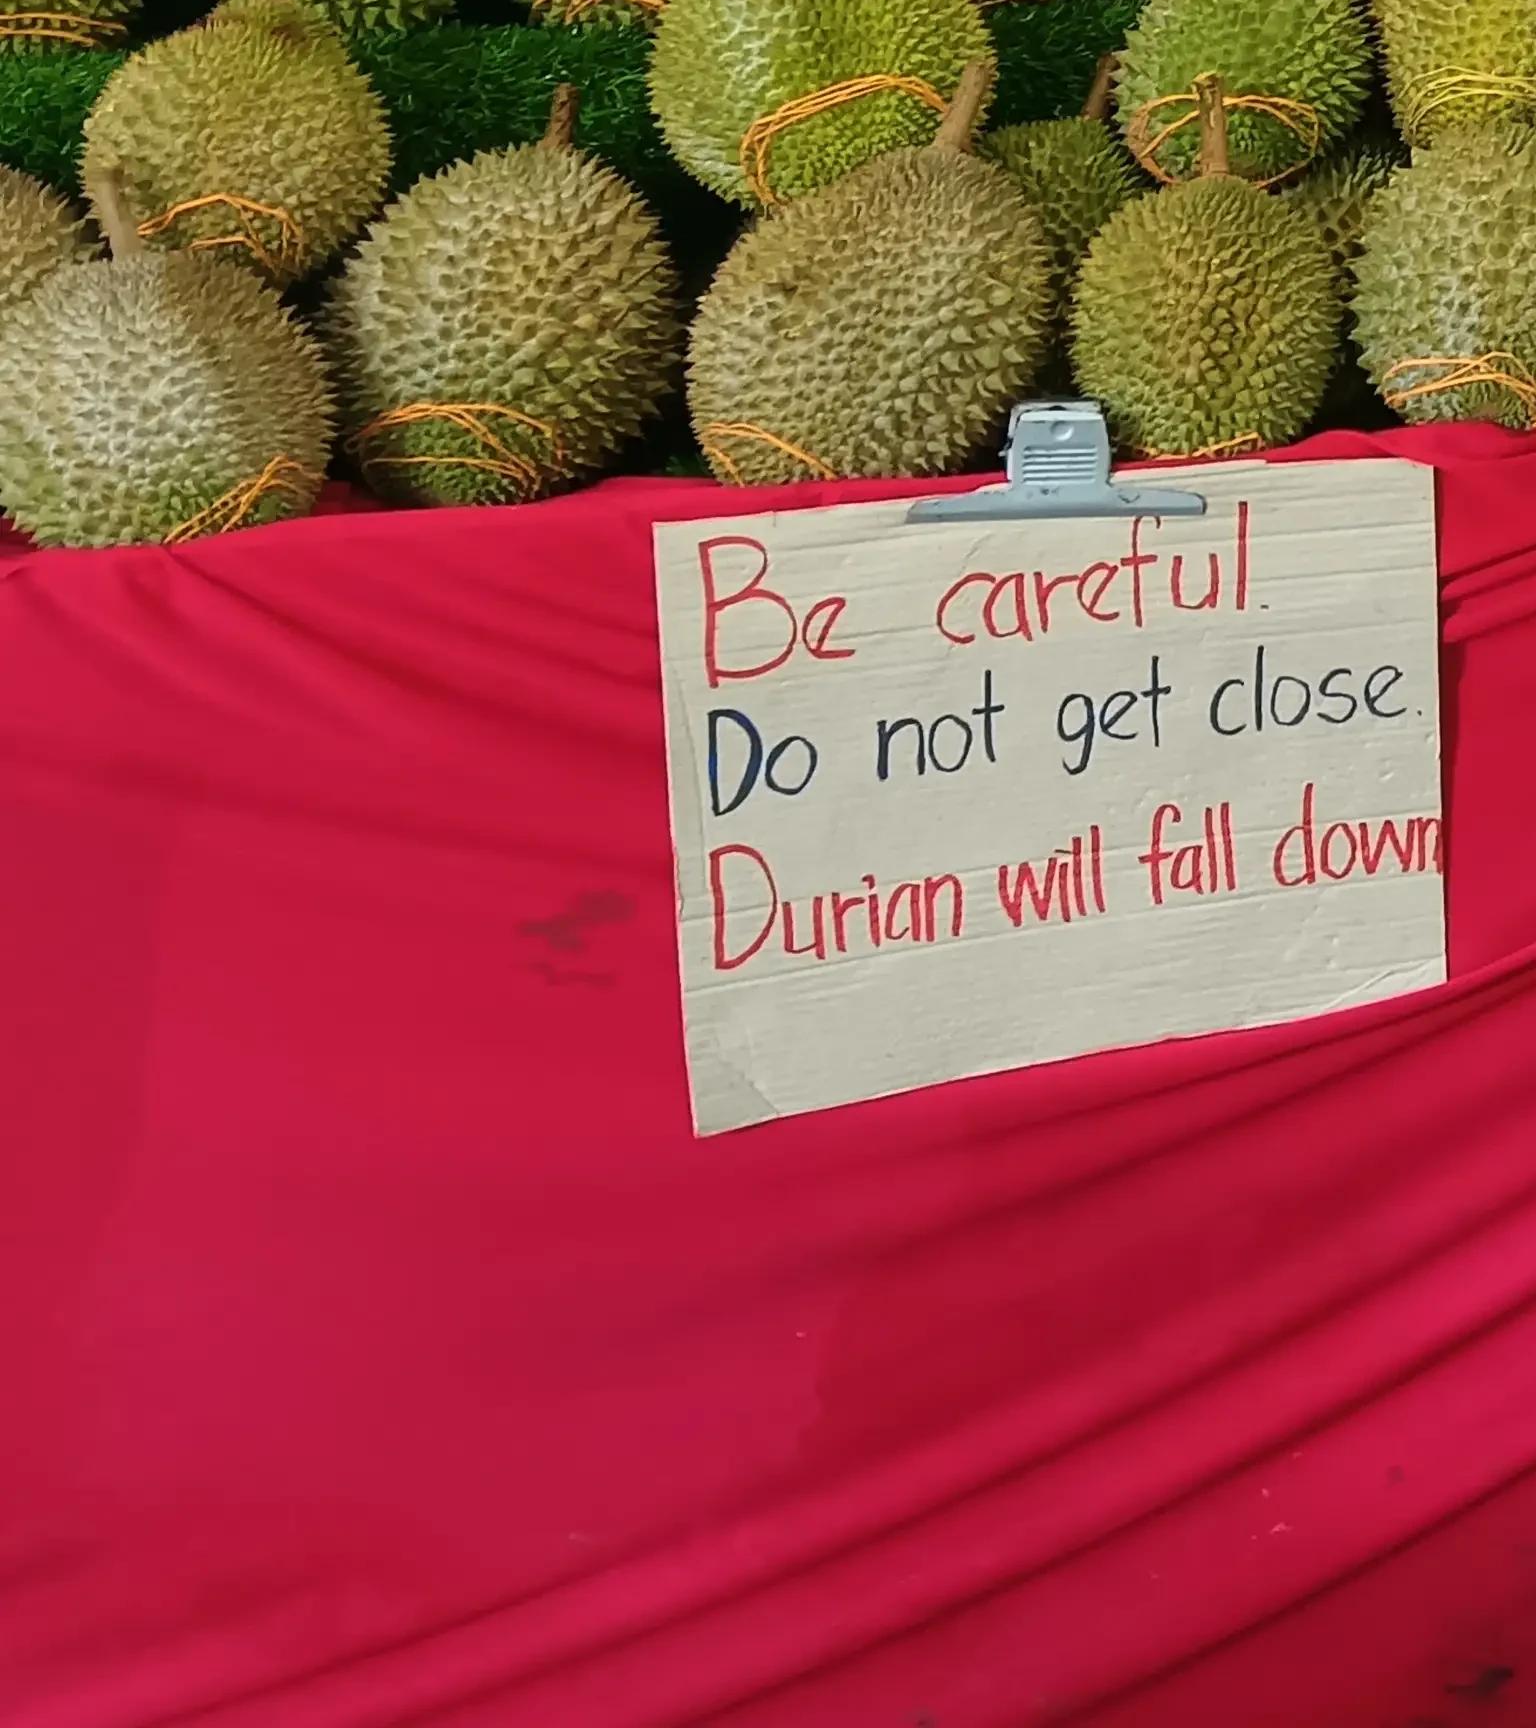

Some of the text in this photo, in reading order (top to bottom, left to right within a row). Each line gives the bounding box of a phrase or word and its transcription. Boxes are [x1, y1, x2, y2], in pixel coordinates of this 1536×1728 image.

[698, 535, 855, 687] Be
[707, 708, 818, 817] Do
[876, 670, 1005, 782] not
[1057, 654, 1171, 775] get
[709, 783, 1443, 970] Durian will fall down
